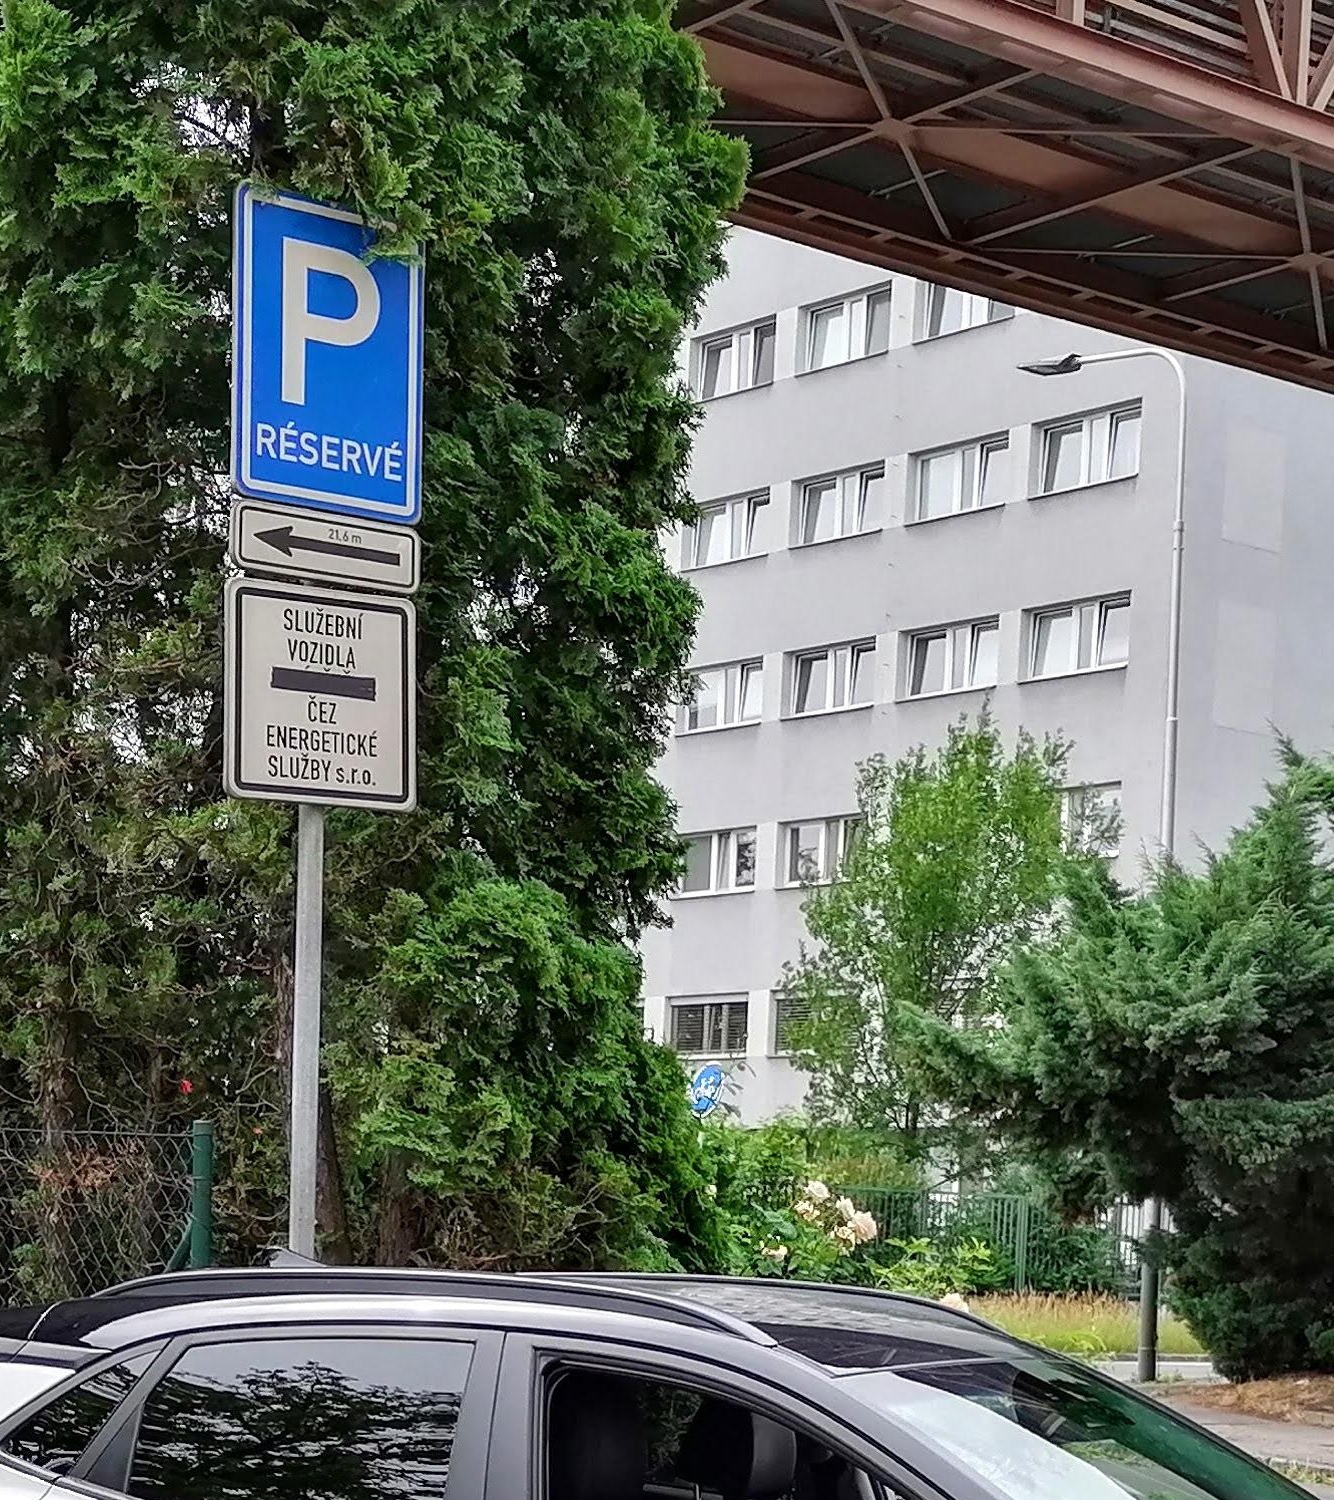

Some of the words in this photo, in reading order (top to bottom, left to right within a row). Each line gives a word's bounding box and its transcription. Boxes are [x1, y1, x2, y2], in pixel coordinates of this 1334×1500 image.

[281, 236, 380, 406] P
[256, 422, 403, 482] RÉSERVÉ
[351, 534, 363, 544] m
[283, 608, 364, 640] SLUŽEBNÍ
[287, 638, 356, 669] VOZIDLA
[307, 695, 337, 725] ČEZ
[267, 725, 378, 757] ENERGETICKÉ
[267, 753, 331, 782] SLUŽBY
[335, 766, 376, 786] s.r.o.
